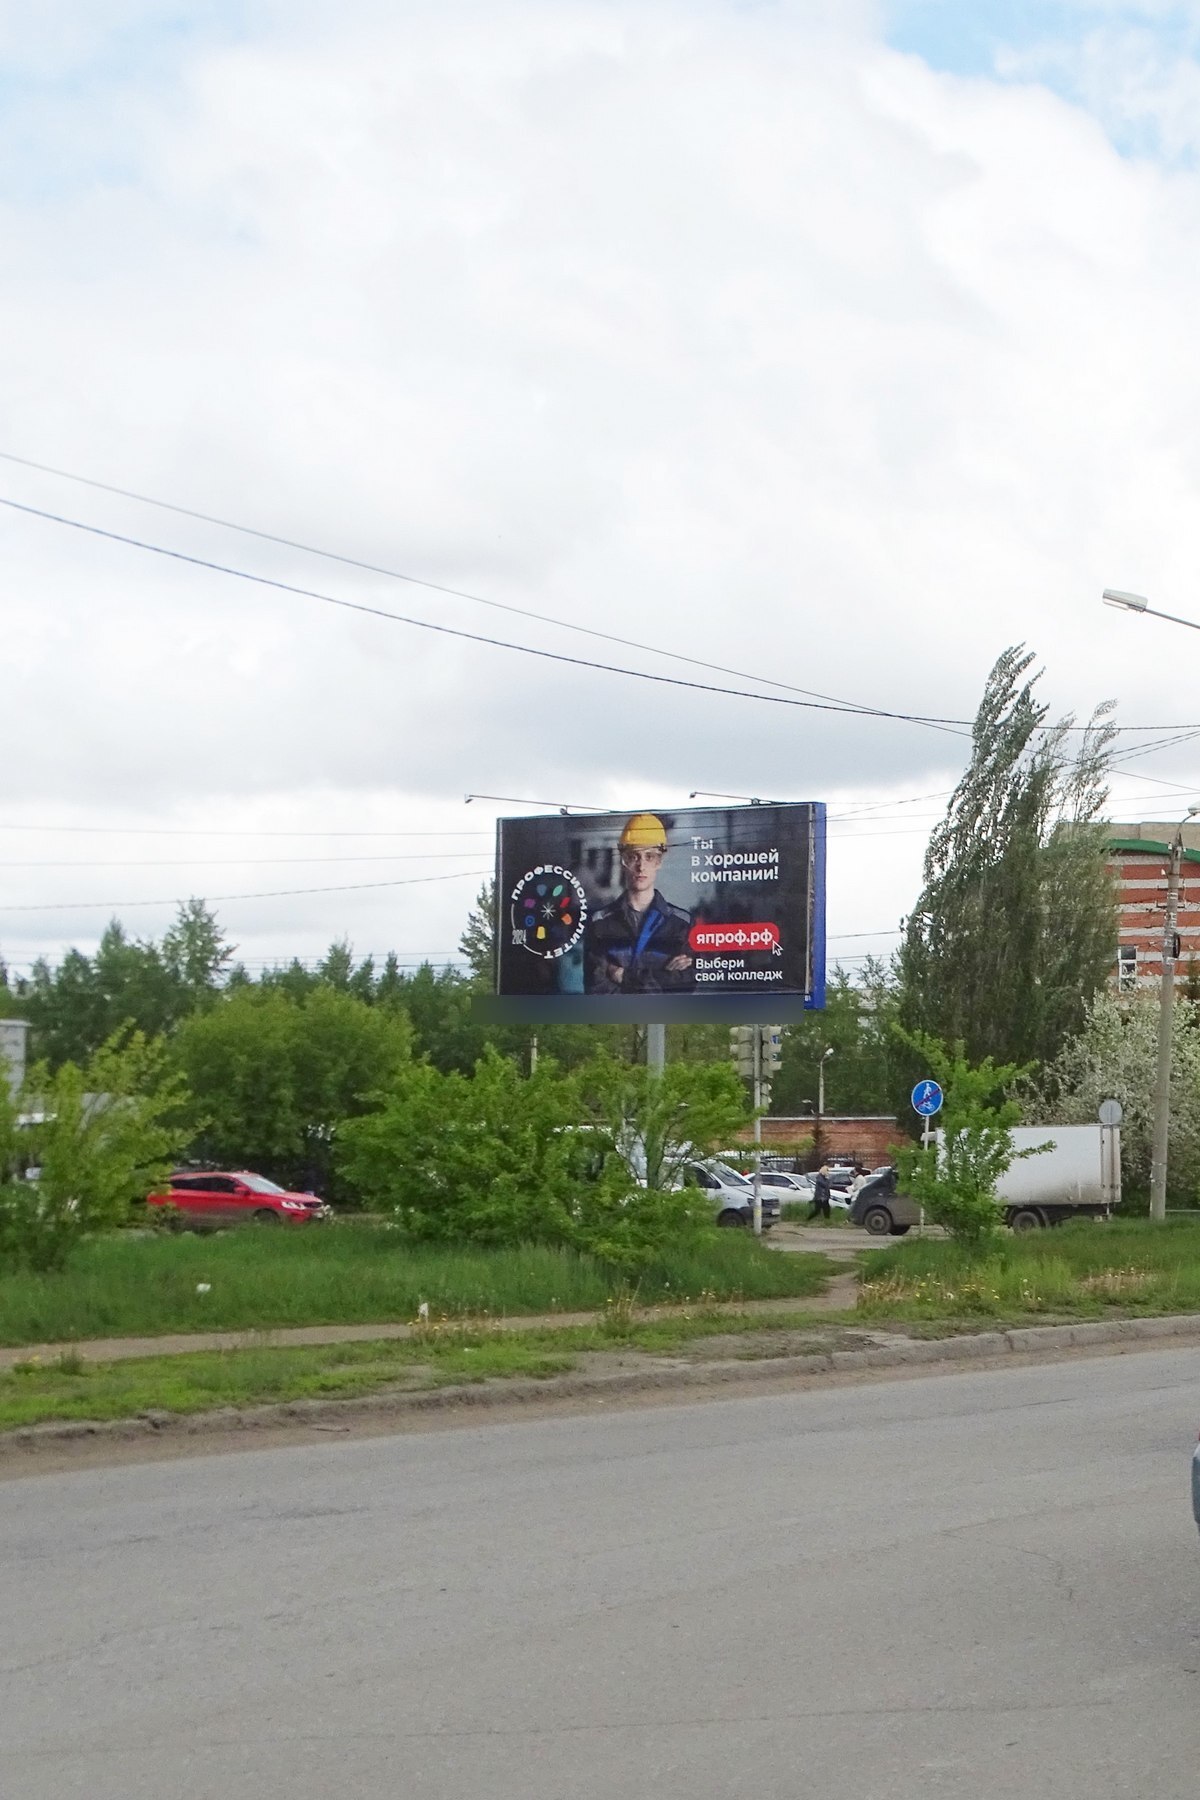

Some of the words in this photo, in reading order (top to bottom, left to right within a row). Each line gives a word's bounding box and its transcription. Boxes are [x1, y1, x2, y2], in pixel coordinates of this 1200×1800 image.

[691, 836, 714, 850] Ты
[691, 856, 700, 867] в
[704, 848, 779, 868] хорошей
[691, 866, 779, 883] компании!
[511, 864, 588, 959] ПРОФЕССИОНАЛИТЕТ
[696, 928, 773, 947] япроф.рф
[695, 957, 745, 971] Выбери
[695, 970, 725, 982] свой
[727, 969, 784, 982] колледж
